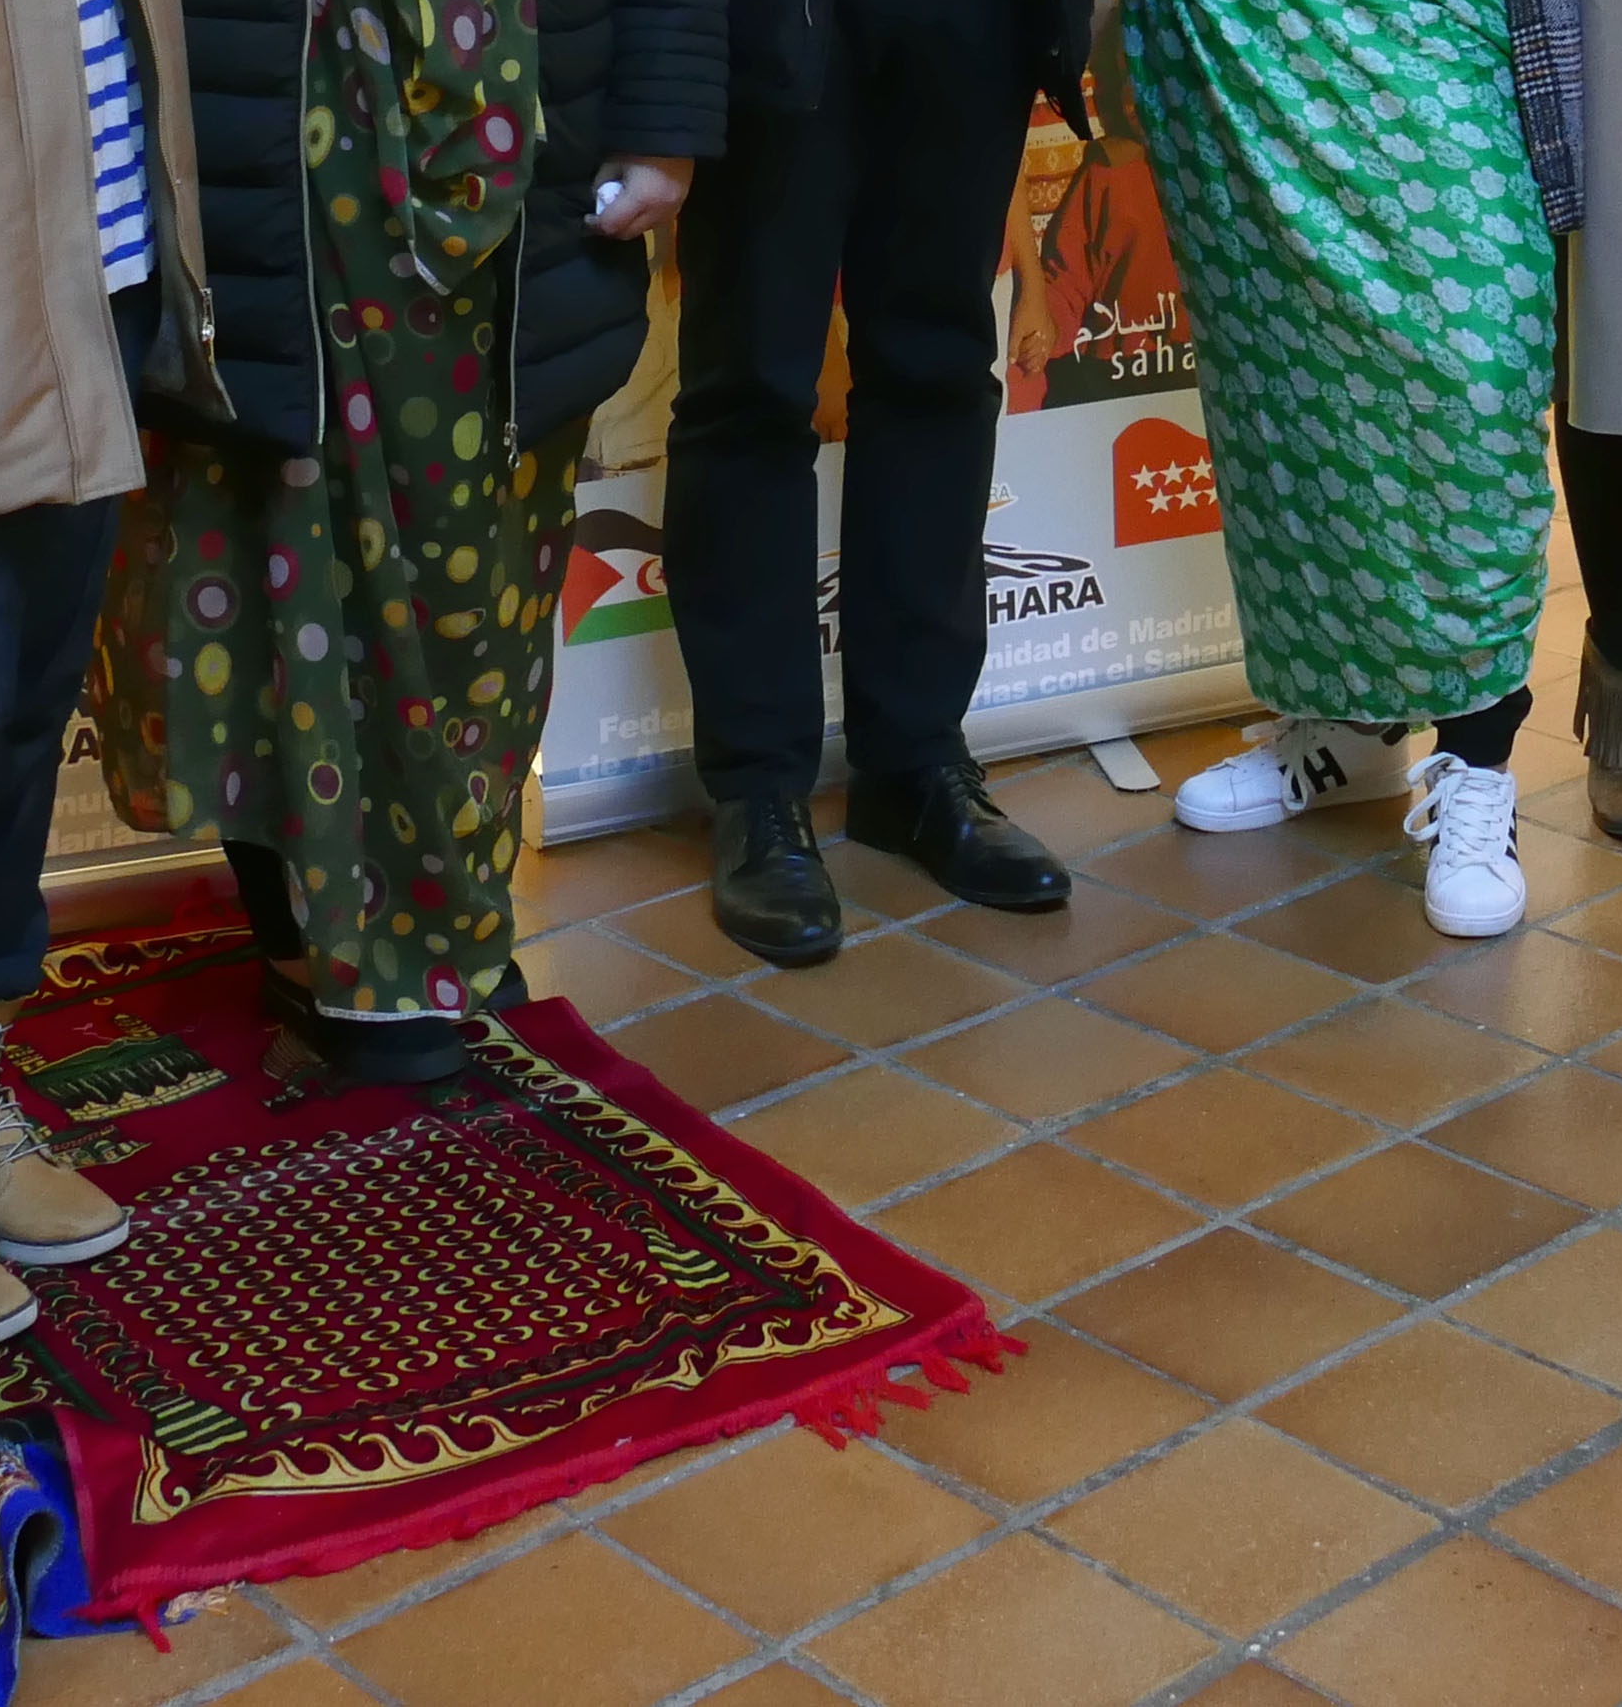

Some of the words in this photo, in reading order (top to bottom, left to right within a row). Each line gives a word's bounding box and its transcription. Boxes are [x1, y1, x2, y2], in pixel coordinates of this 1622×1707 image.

[1073, 290, 1177, 364] السلام
[1110, 335, 1197, 380] sáha
[988, 575, 1105, 625] HARA
[985, 633, 1071, 670] nidad
[1080, 627, 1119, 654] de
[1129, 603, 1233, 645] Madrid
[1039, 667, 1097, 695] con
[1105, 655, 1133, 681] el
[599, 708, 694, 744] Feder
